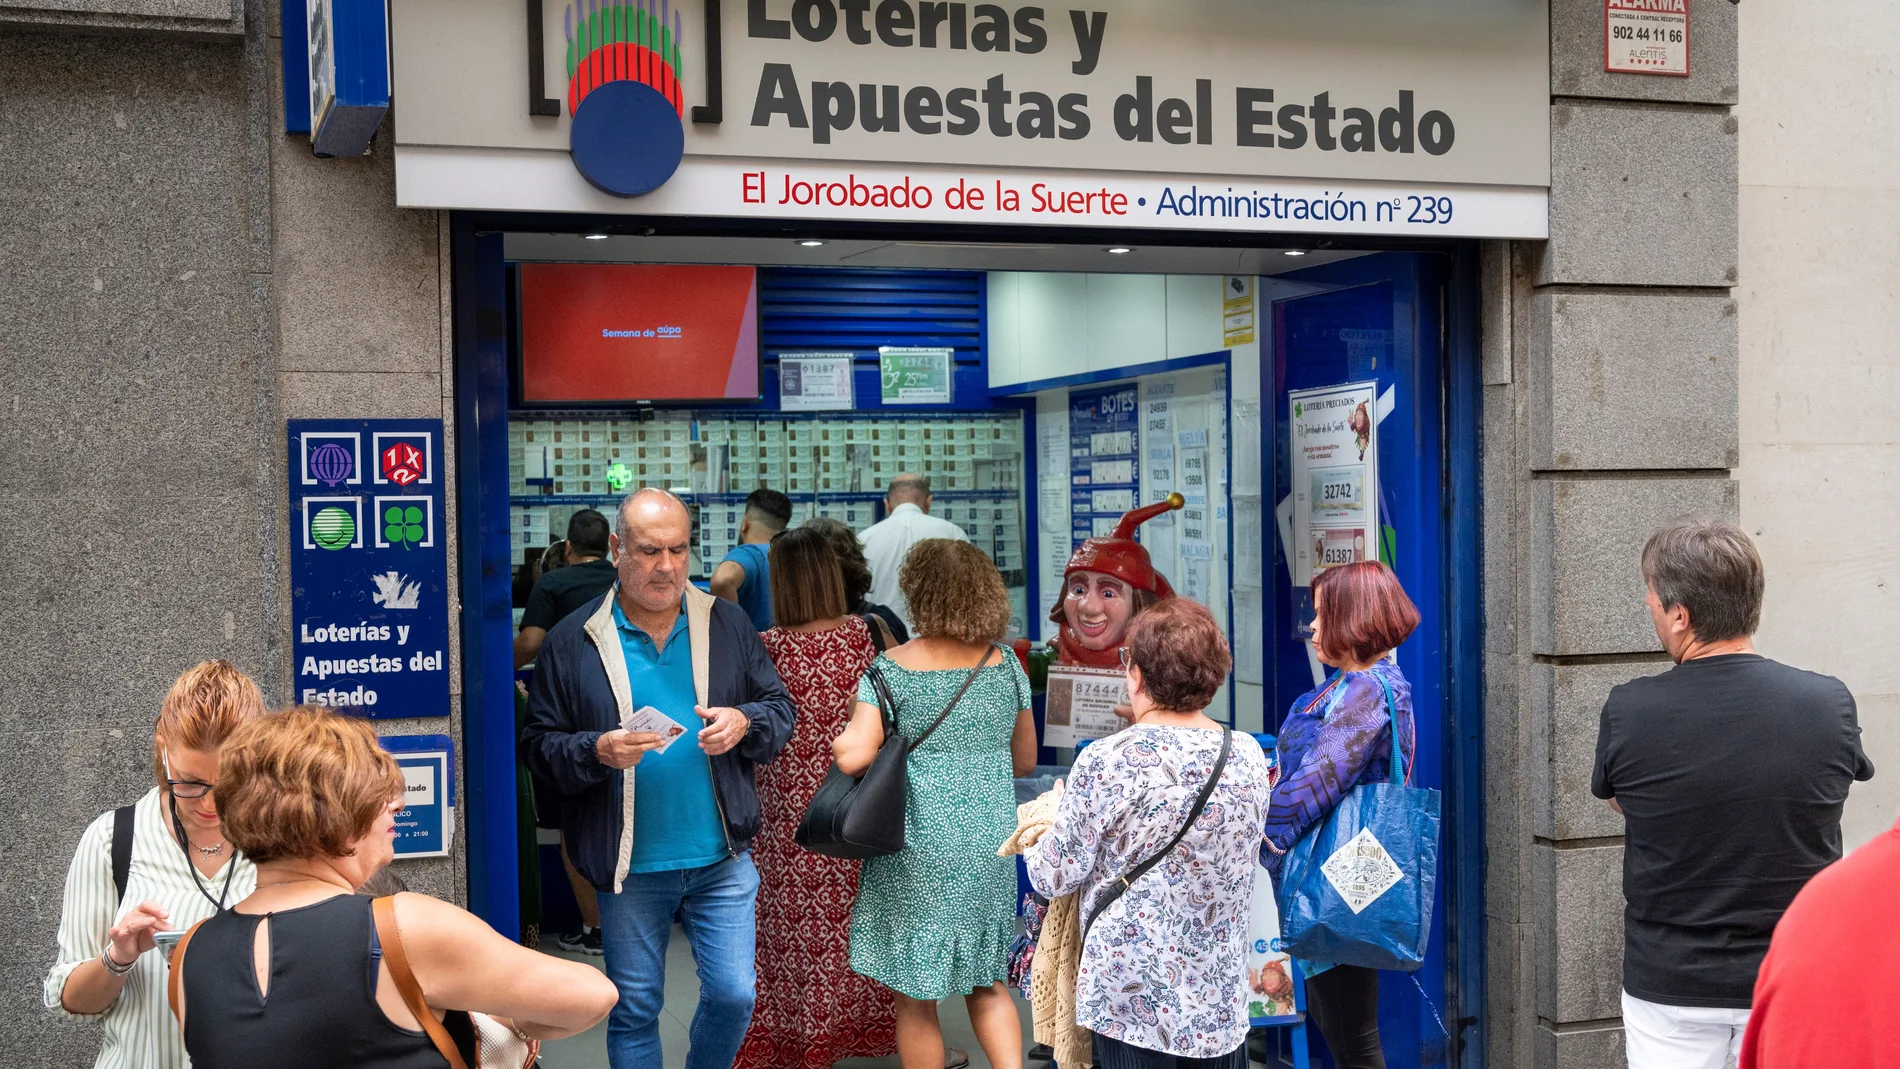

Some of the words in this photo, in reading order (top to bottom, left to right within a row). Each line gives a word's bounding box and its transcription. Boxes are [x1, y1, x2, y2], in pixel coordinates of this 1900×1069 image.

[1069, 10, 1108, 75] y
[1613, 25, 1633, 40] 902
[1636, 27, 1650, 41] 44
[1653, 28, 1665, 42] 11
[1669, 29, 1683, 43] 66
[750, 63, 1091, 144] Apuestas
[1113, 75, 1213, 145] del
[1236, 87, 1455, 156] Estado
[742, 171, 766, 204] El
[779, 174, 932, 209] Jorobado
[945, 178, 984, 211] de
[996, 180, 1020, 212] la
[1031, 183, 1128, 215] Suerte
[1156, 186, 1366, 222] Administración
[1407, 195, 1453, 224] 239
[602, 328, 641, 338] Semana
[643, 329, 655, 337] de
[657, 325, 682, 336] aúpa
[803, 364, 835, 374] 61387
[1101, 392, 1134, 414] BOTES
[1325, 397, 1355, 409] PRECIADOS
[1324, 483, 1351, 499] 32742
[1325, 548, 1352, 564] 61387
[301, 620, 391, 643] Loterías
[397, 625, 410, 645] y
[301, 653, 402, 680] Apuestas
[409, 650, 442, 671] del
[303, 685, 377, 707] Estado
[1075, 683, 1119, 694] 87444
[1256, 941, 1268, 950] 45
